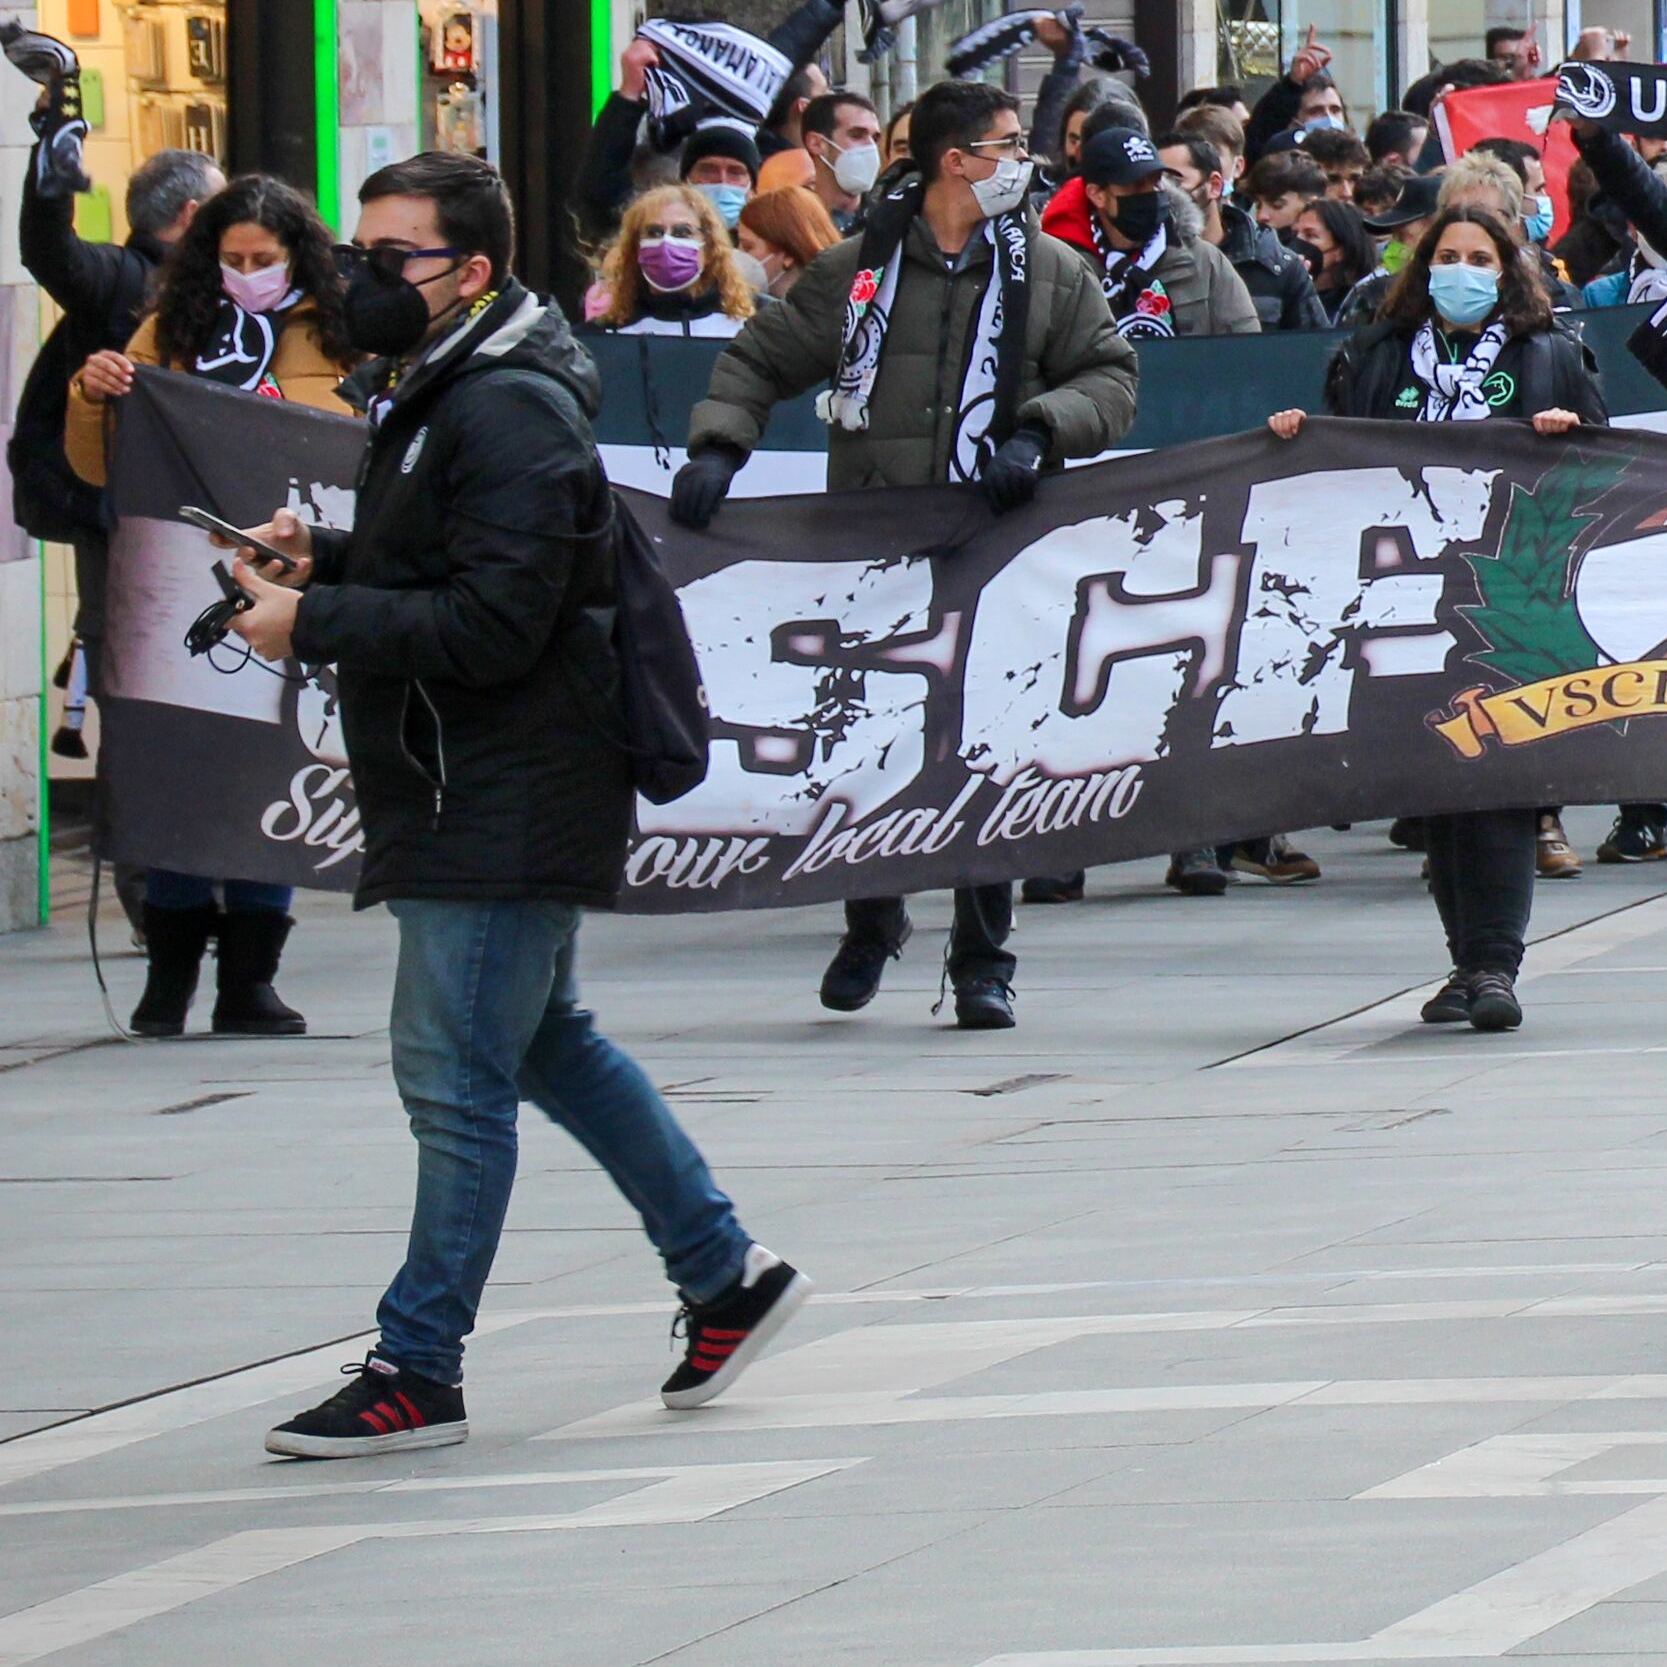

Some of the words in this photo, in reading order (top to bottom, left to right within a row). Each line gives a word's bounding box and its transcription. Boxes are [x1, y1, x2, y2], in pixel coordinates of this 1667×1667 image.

[624, 830, 768, 890] our
[782, 773, 986, 884] local
[976, 764, 1144, 847] team
